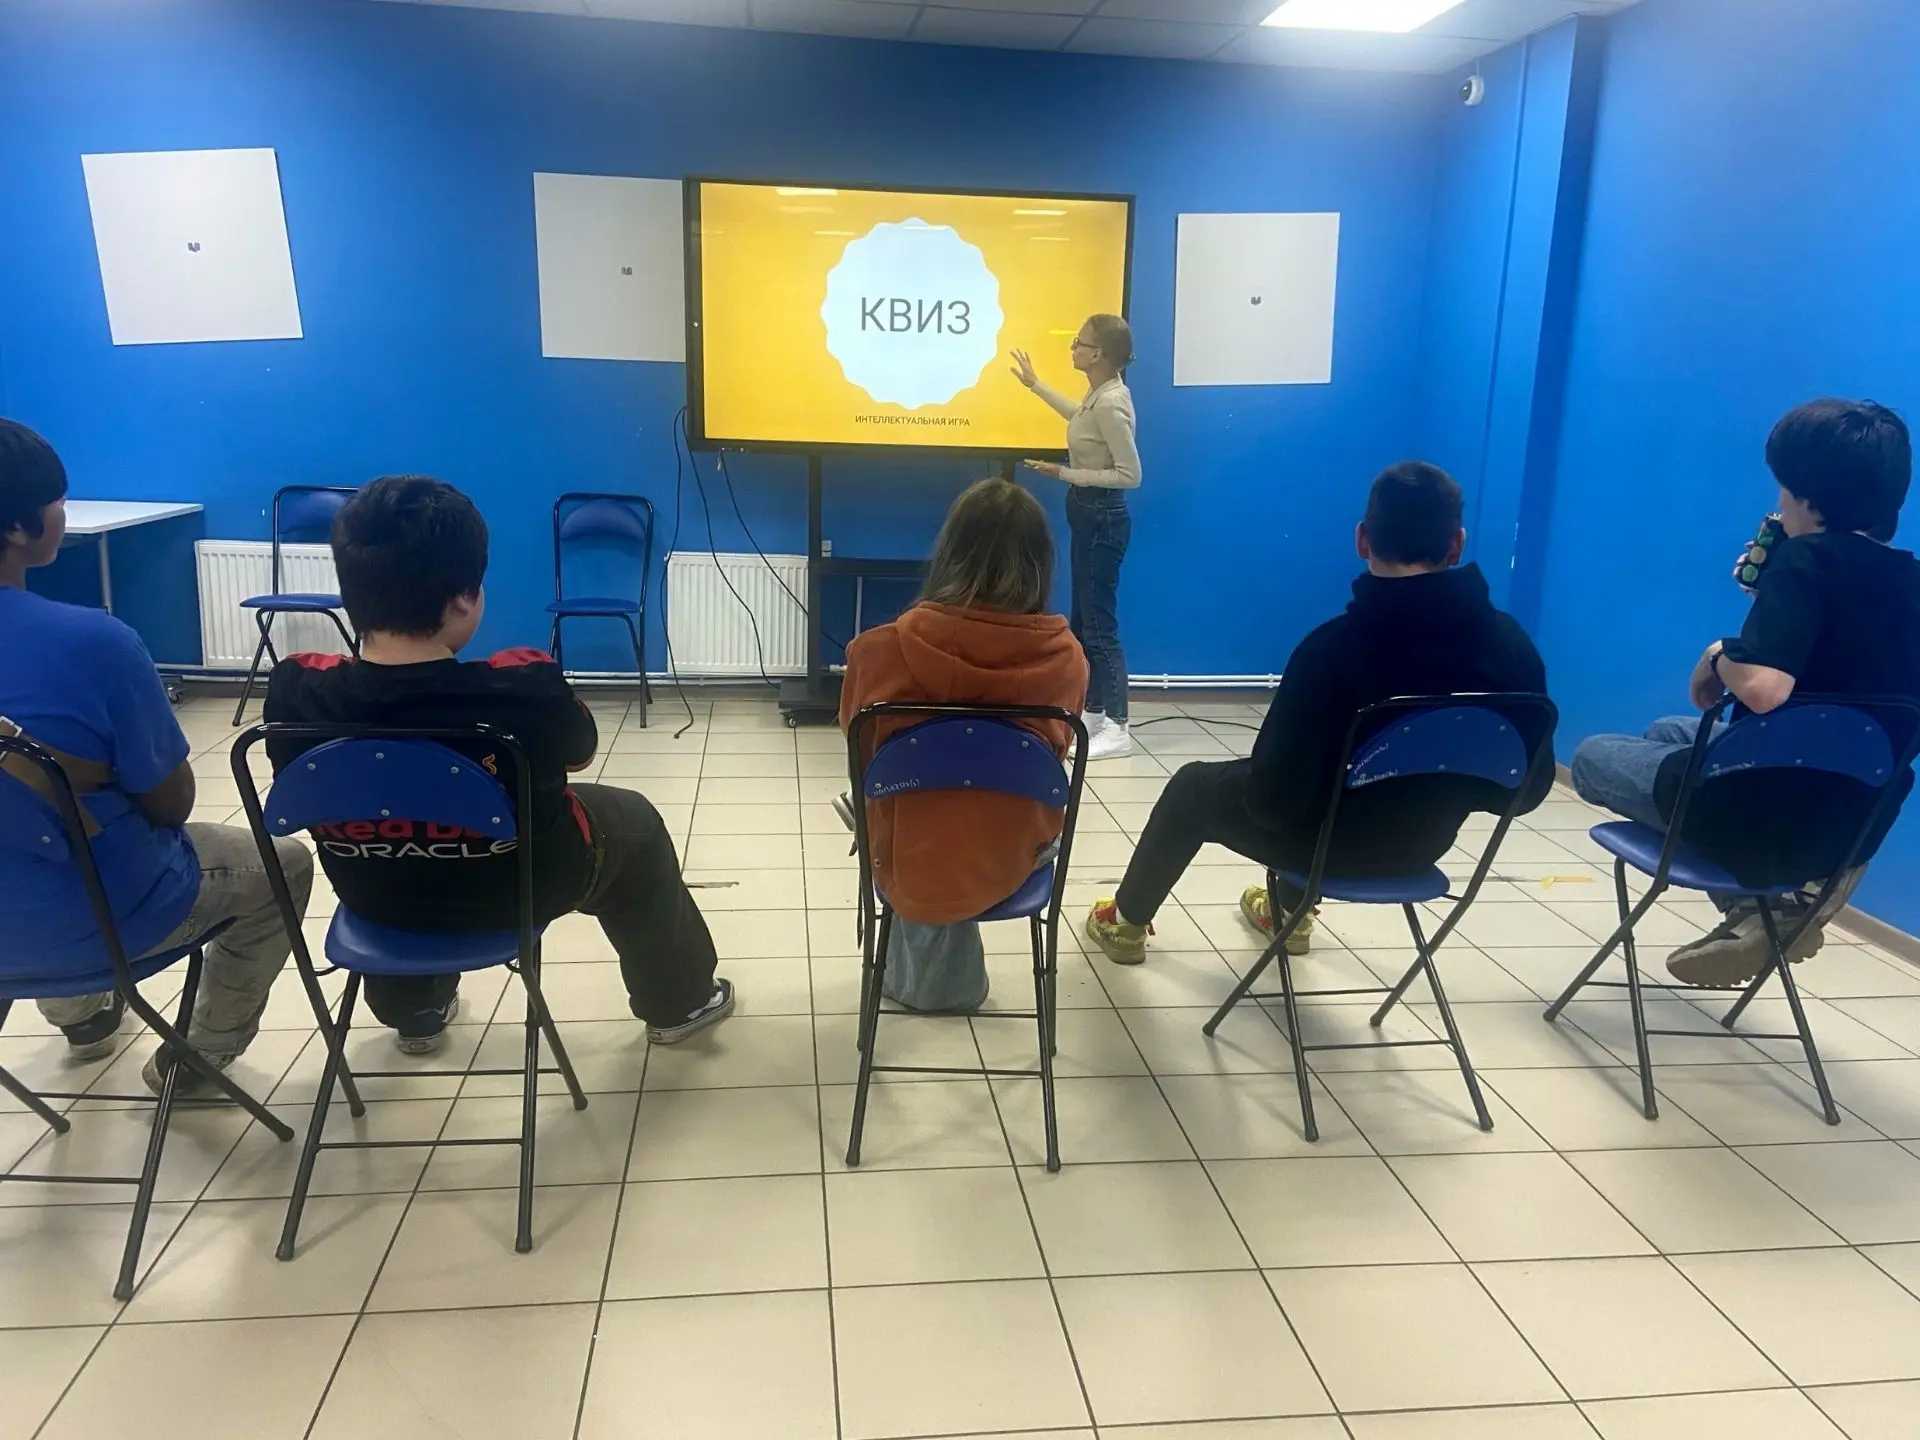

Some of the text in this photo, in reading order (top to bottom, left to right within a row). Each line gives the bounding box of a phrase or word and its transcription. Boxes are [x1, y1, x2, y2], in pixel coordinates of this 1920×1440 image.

[861, 297, 970, 335] КВИЗ
[855, 415, 970, 427] ИНТЕЛЛЕКТУАЛЬНАЯ ИГРА
[322, 838, 517, 859] ORACLE
